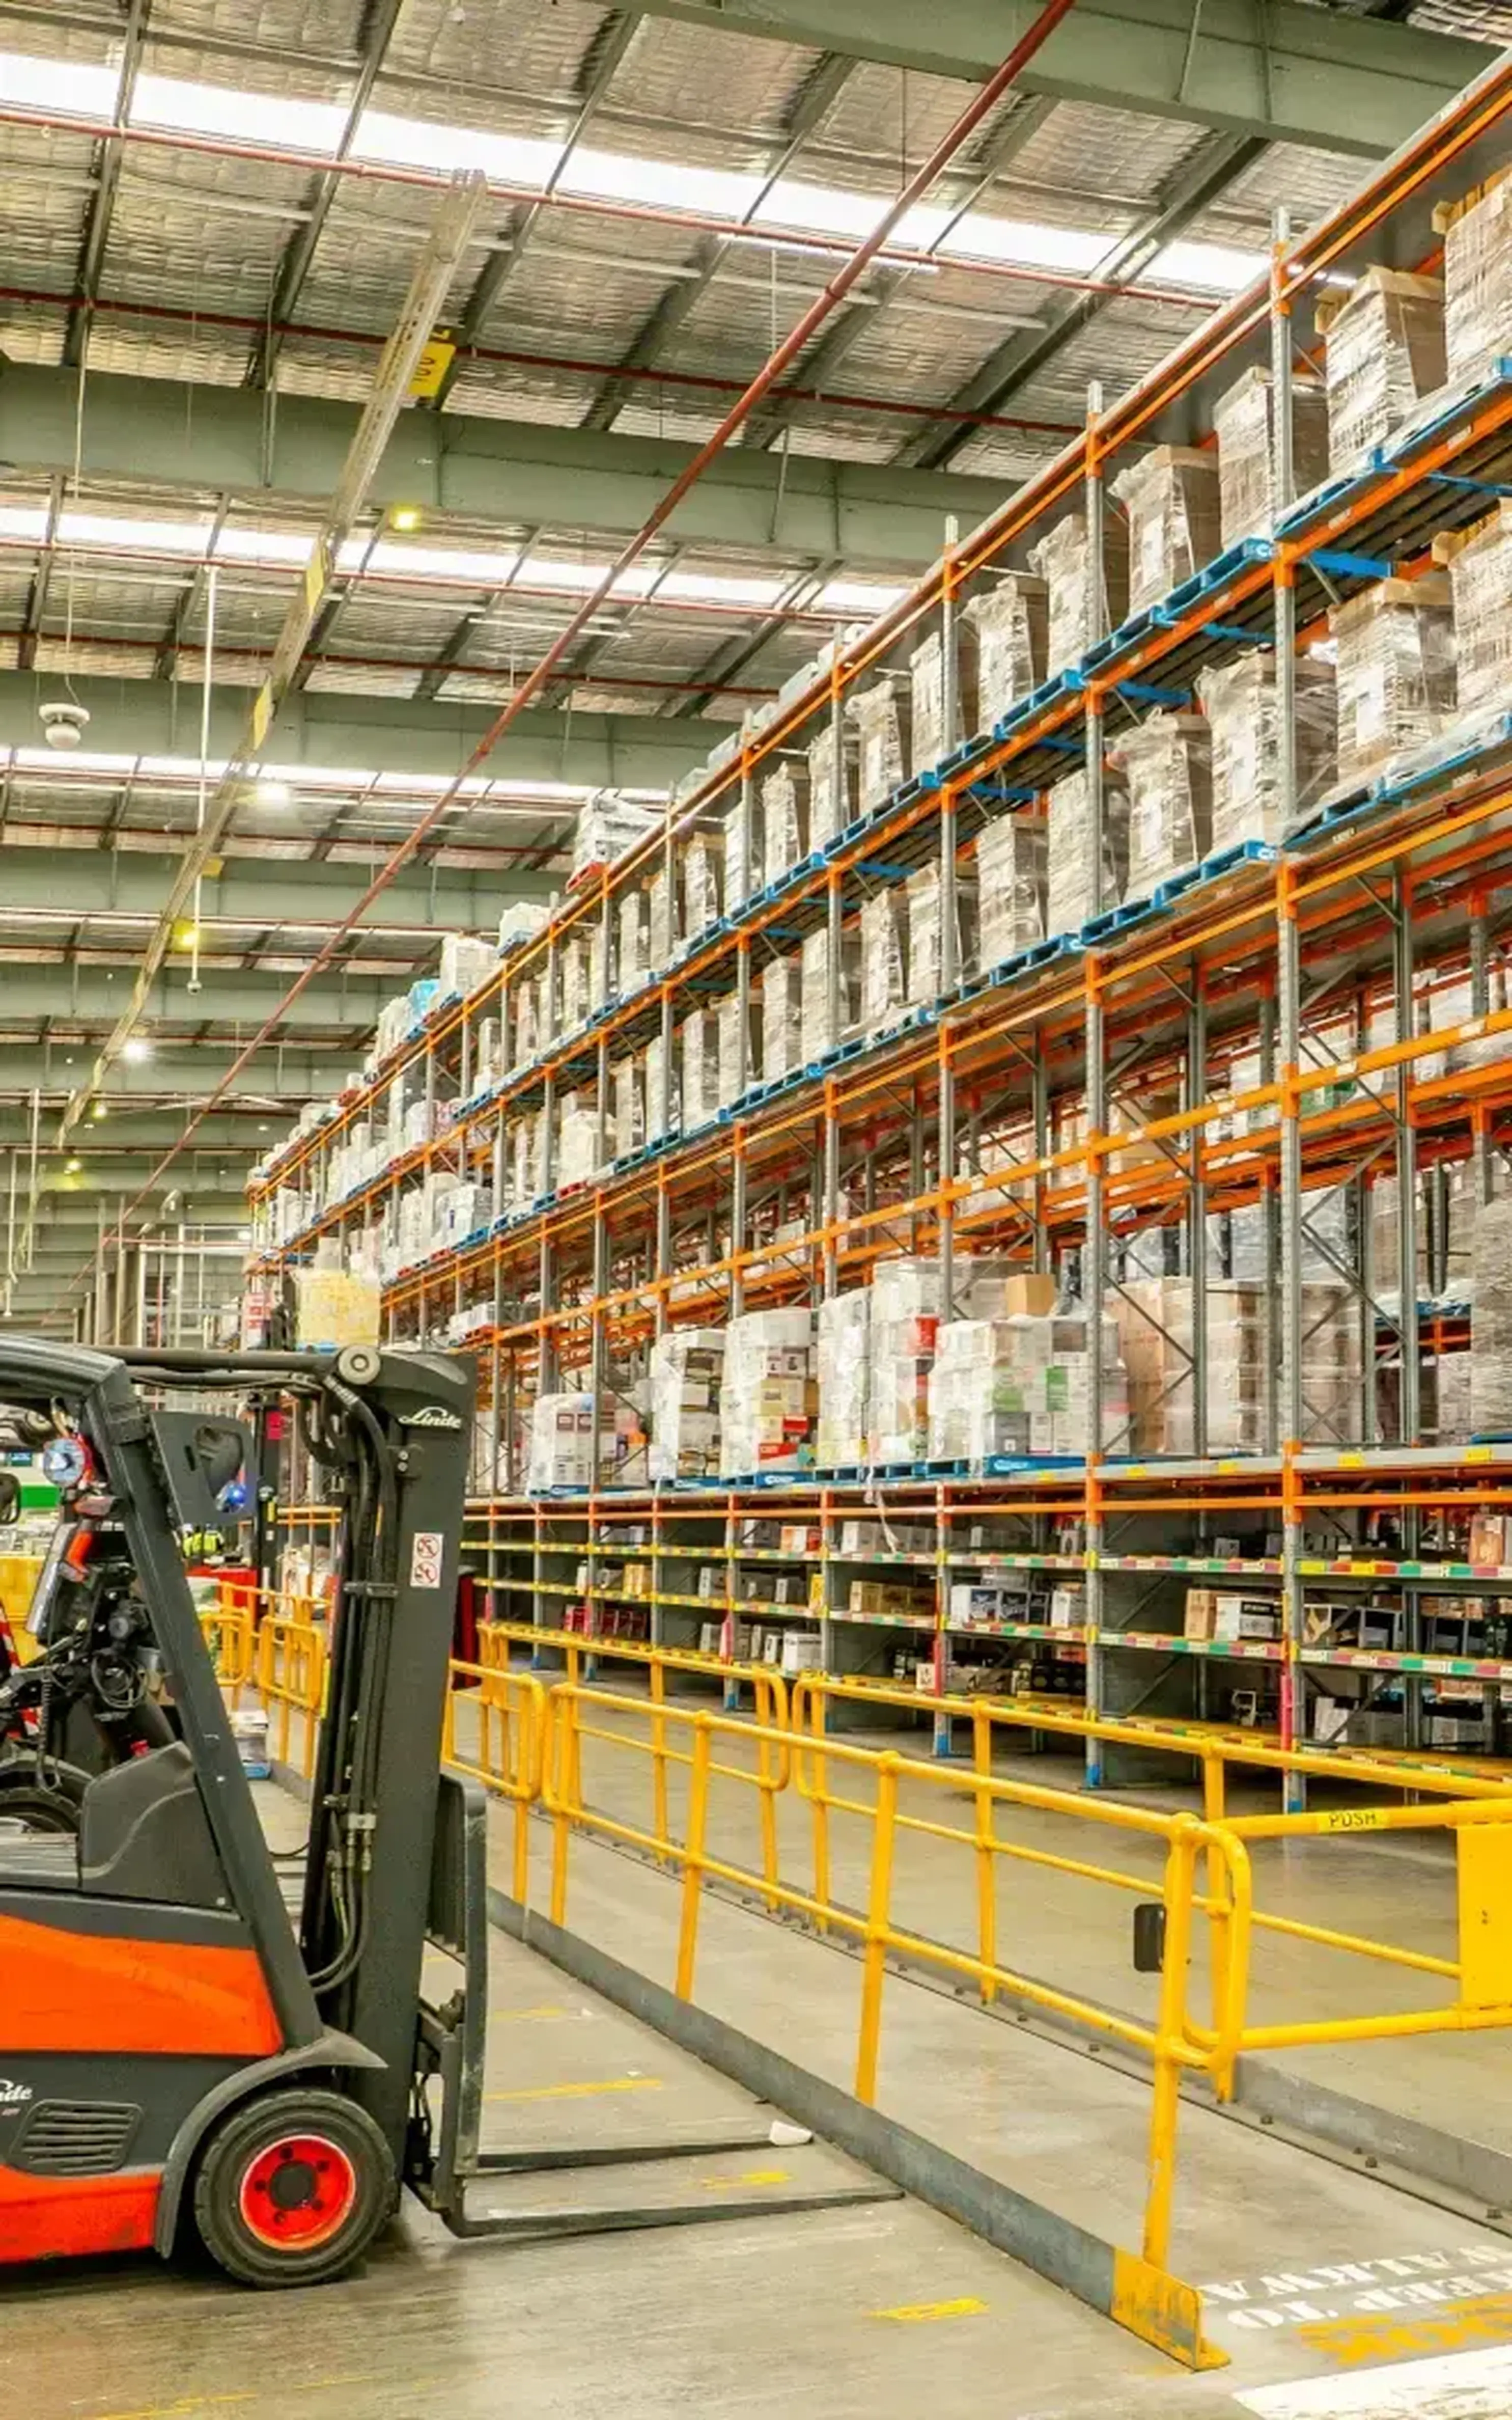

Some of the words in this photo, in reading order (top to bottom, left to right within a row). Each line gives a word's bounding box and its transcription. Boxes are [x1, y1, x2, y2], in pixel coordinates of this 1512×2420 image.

[398, 1406, 461, 1429] Linde
[1328, 1812, 1377, 1828] PUSH
[1199, 2245, 1512, 2306] WALKWA
[1227, 2300, 1338, 2329] TO
